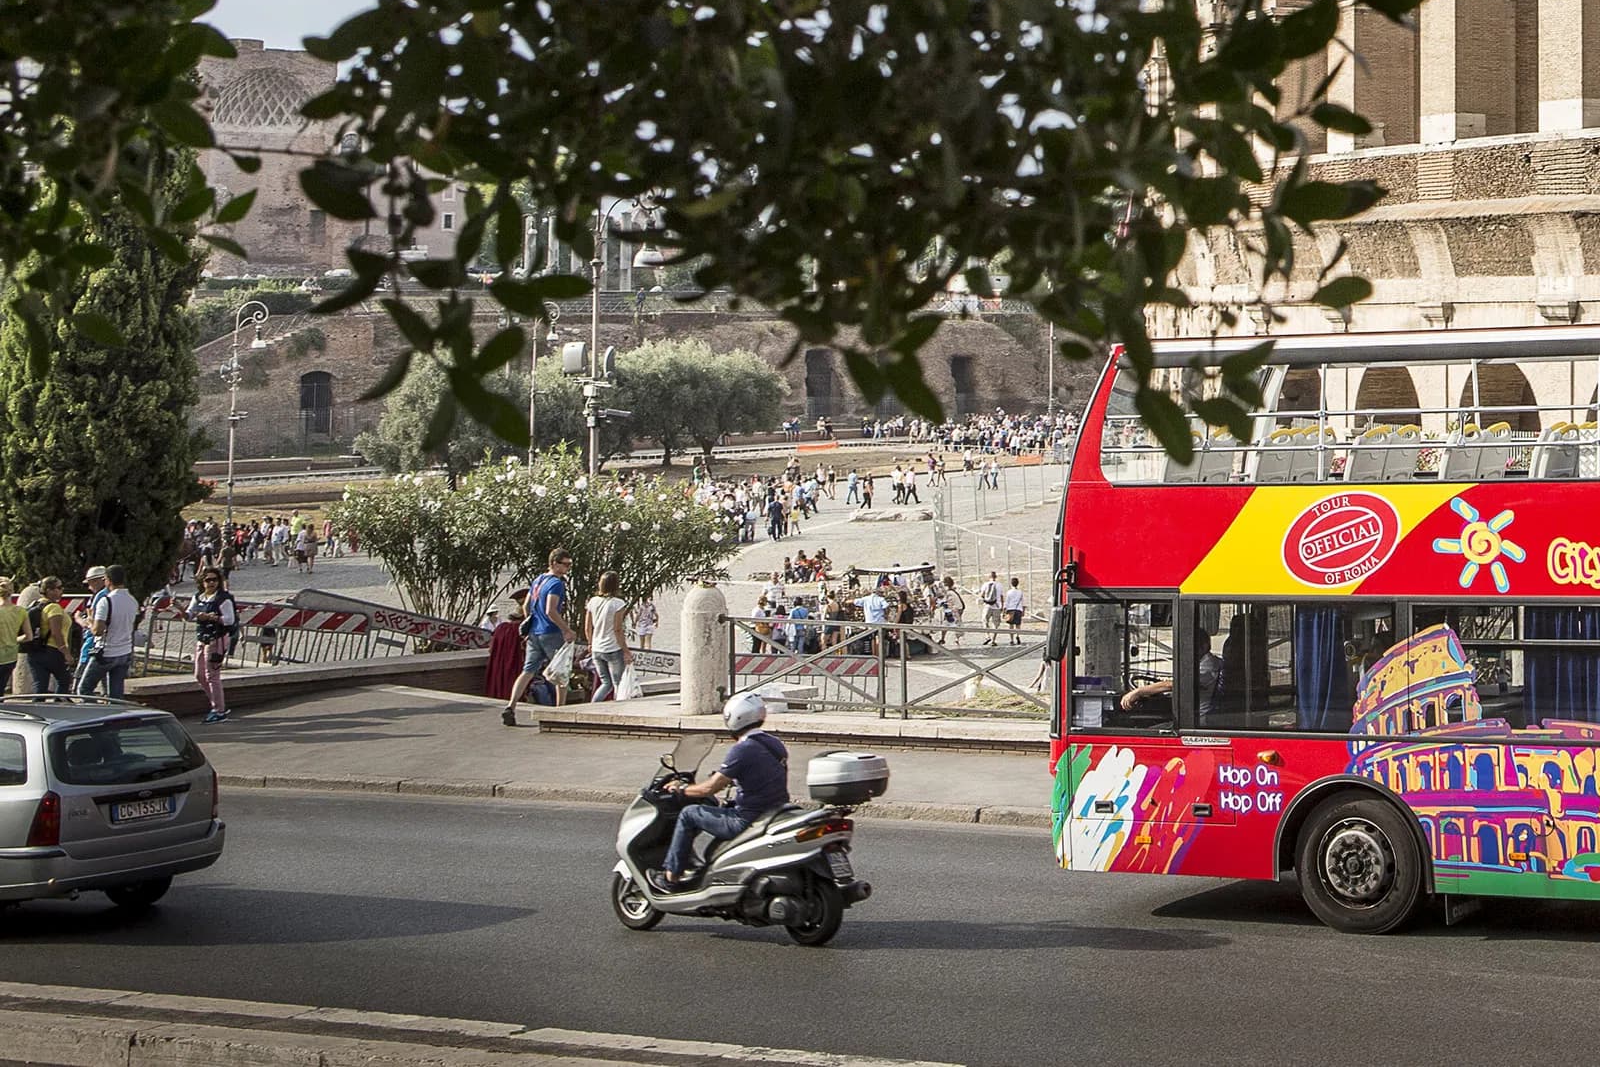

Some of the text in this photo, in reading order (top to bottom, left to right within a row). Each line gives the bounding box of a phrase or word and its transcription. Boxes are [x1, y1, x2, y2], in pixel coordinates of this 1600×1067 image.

[1312, 496, 1351, 517] TOUR
[1302, 520, 1380, 559] OFFICIAL
[1325, 555, 1380, 584] OF ROMA
[1218, 765, 1278, 788] Hop On
[1220, 791, 1283, 814] Hop Off
